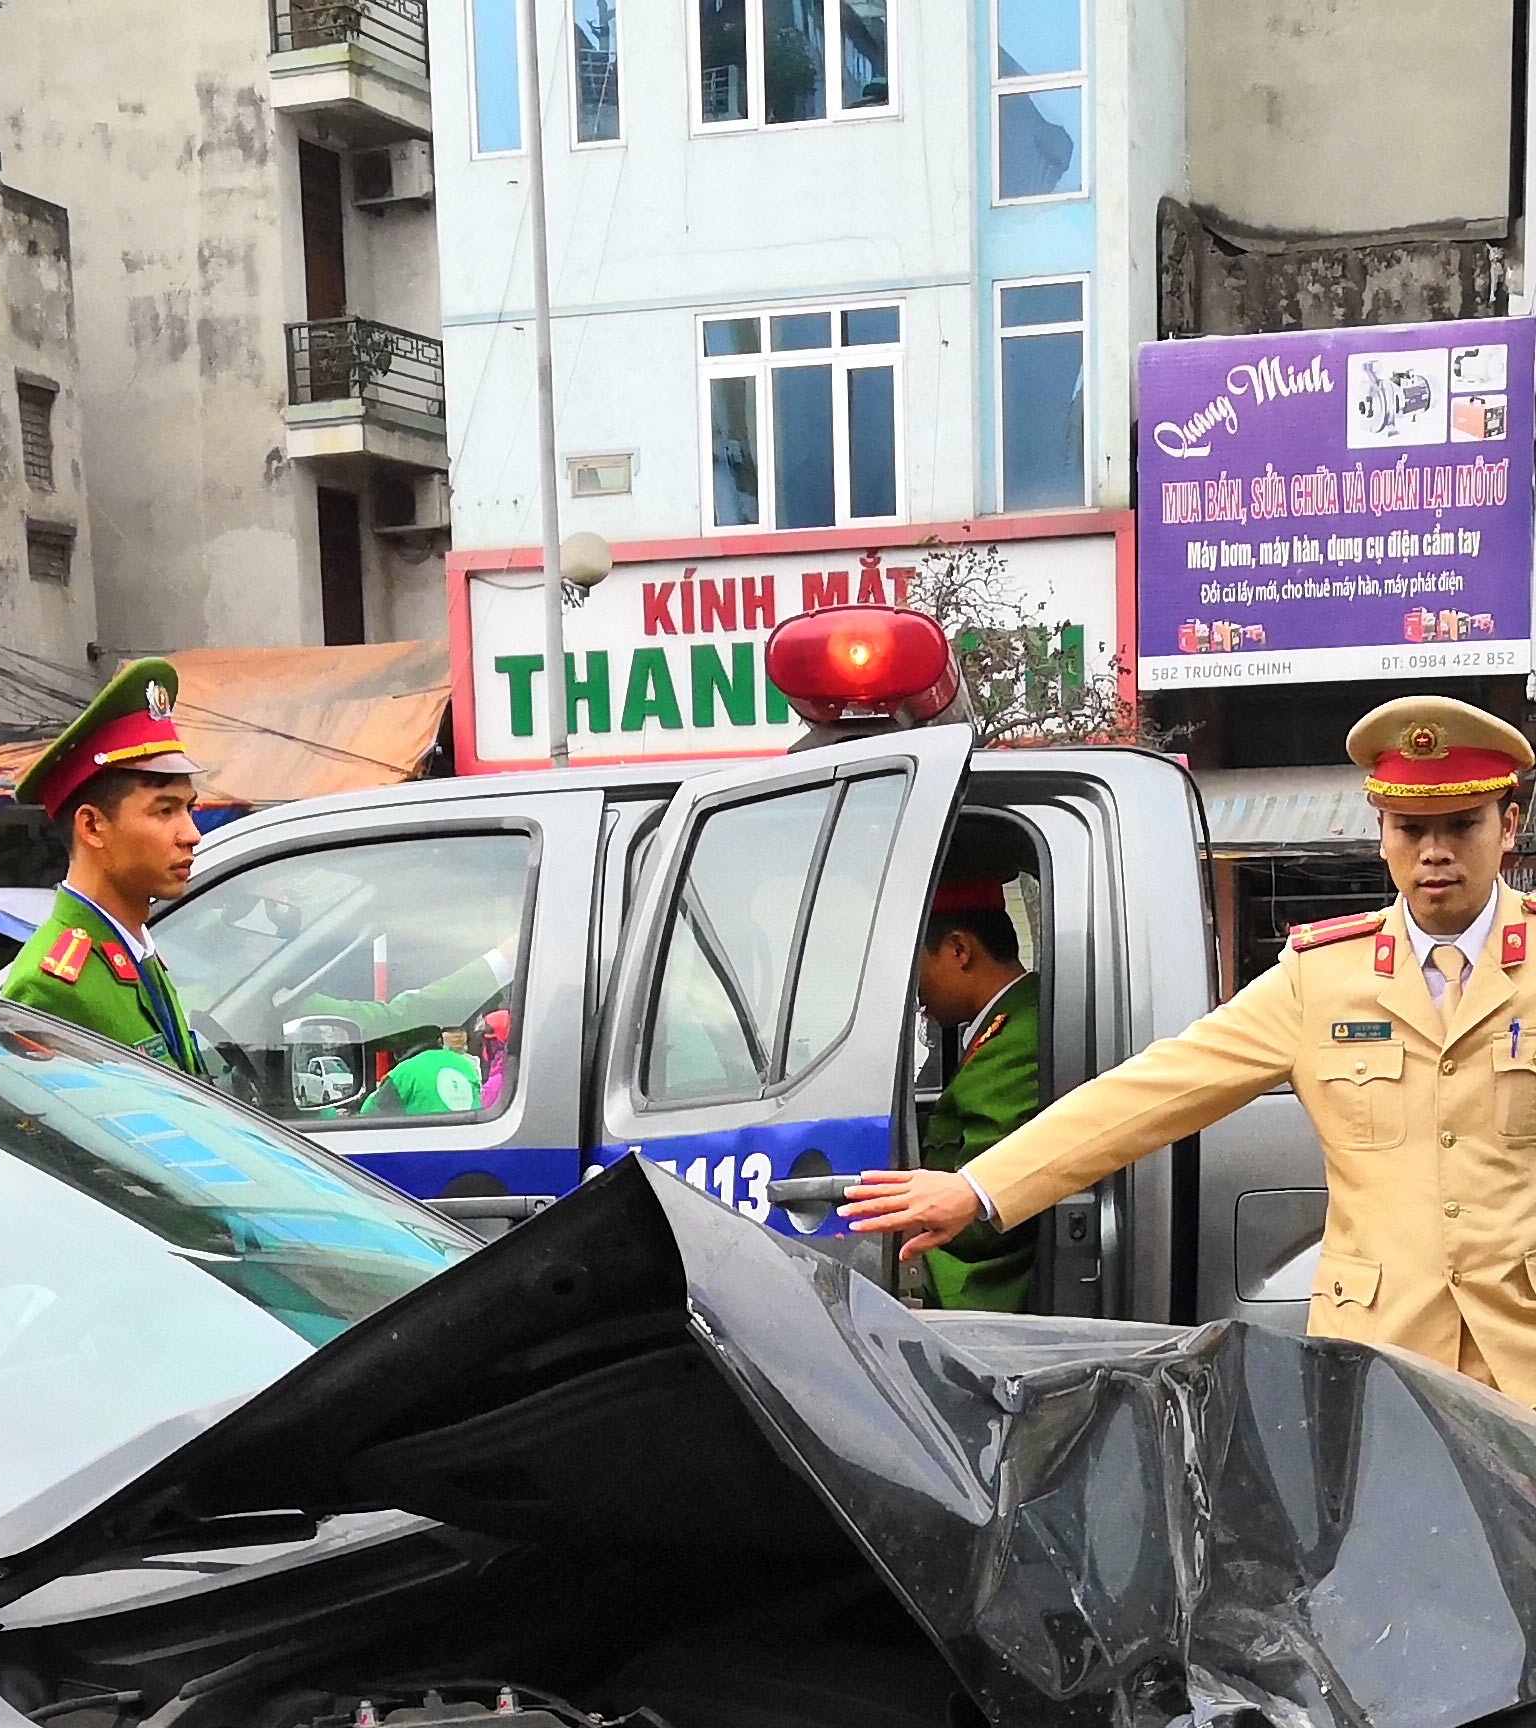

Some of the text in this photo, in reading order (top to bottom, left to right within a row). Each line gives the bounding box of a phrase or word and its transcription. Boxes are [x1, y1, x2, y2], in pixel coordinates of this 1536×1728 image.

[1154, 354, 1335, 459] Quang Minh
[1162, 481, 1202, 524] MUA
[1205, 471, 1247, 525] BÁN,
[1250, 463, 1288, 519] SỬA
[1341, 462, 1366, 513] VÀ
[1423, 466, 1453, 518] LẠI
[1187, 540, 1218, 571] Máy
[1220, 541, 1256, 569] bơm,
[1260, 536, 1290, 568] máy
[1293, 535, 1324, 564] hàn,
[1327, 534, 1363, 566] dụng
[1366, 536, 1384, 564] cụ
[1388, 530, 1420, 563] điện
[1458, 527, 1481, 558] tay
[643, 567, 776, 637] KÍNH
[1281, 579, 1303, 600] cho
[1303, 576, 1331, 598] thuê
[1332, 577, 1356, 602] máy
[1384, 573, 1409, 598] máy
[1410, 570, 1436, 597] phát
[1438, 570, 1464, 595] điện
[1151, 665, 1179, 682] 582
[1247, 660, 1292, 677] CHINH
[1381, 653, 1405, 671] ĐT:
[1408, 652, 1447, 670] 0984
[1451, 651, 1481, 668] 422
[1485, 650, 1516, 667] 852
